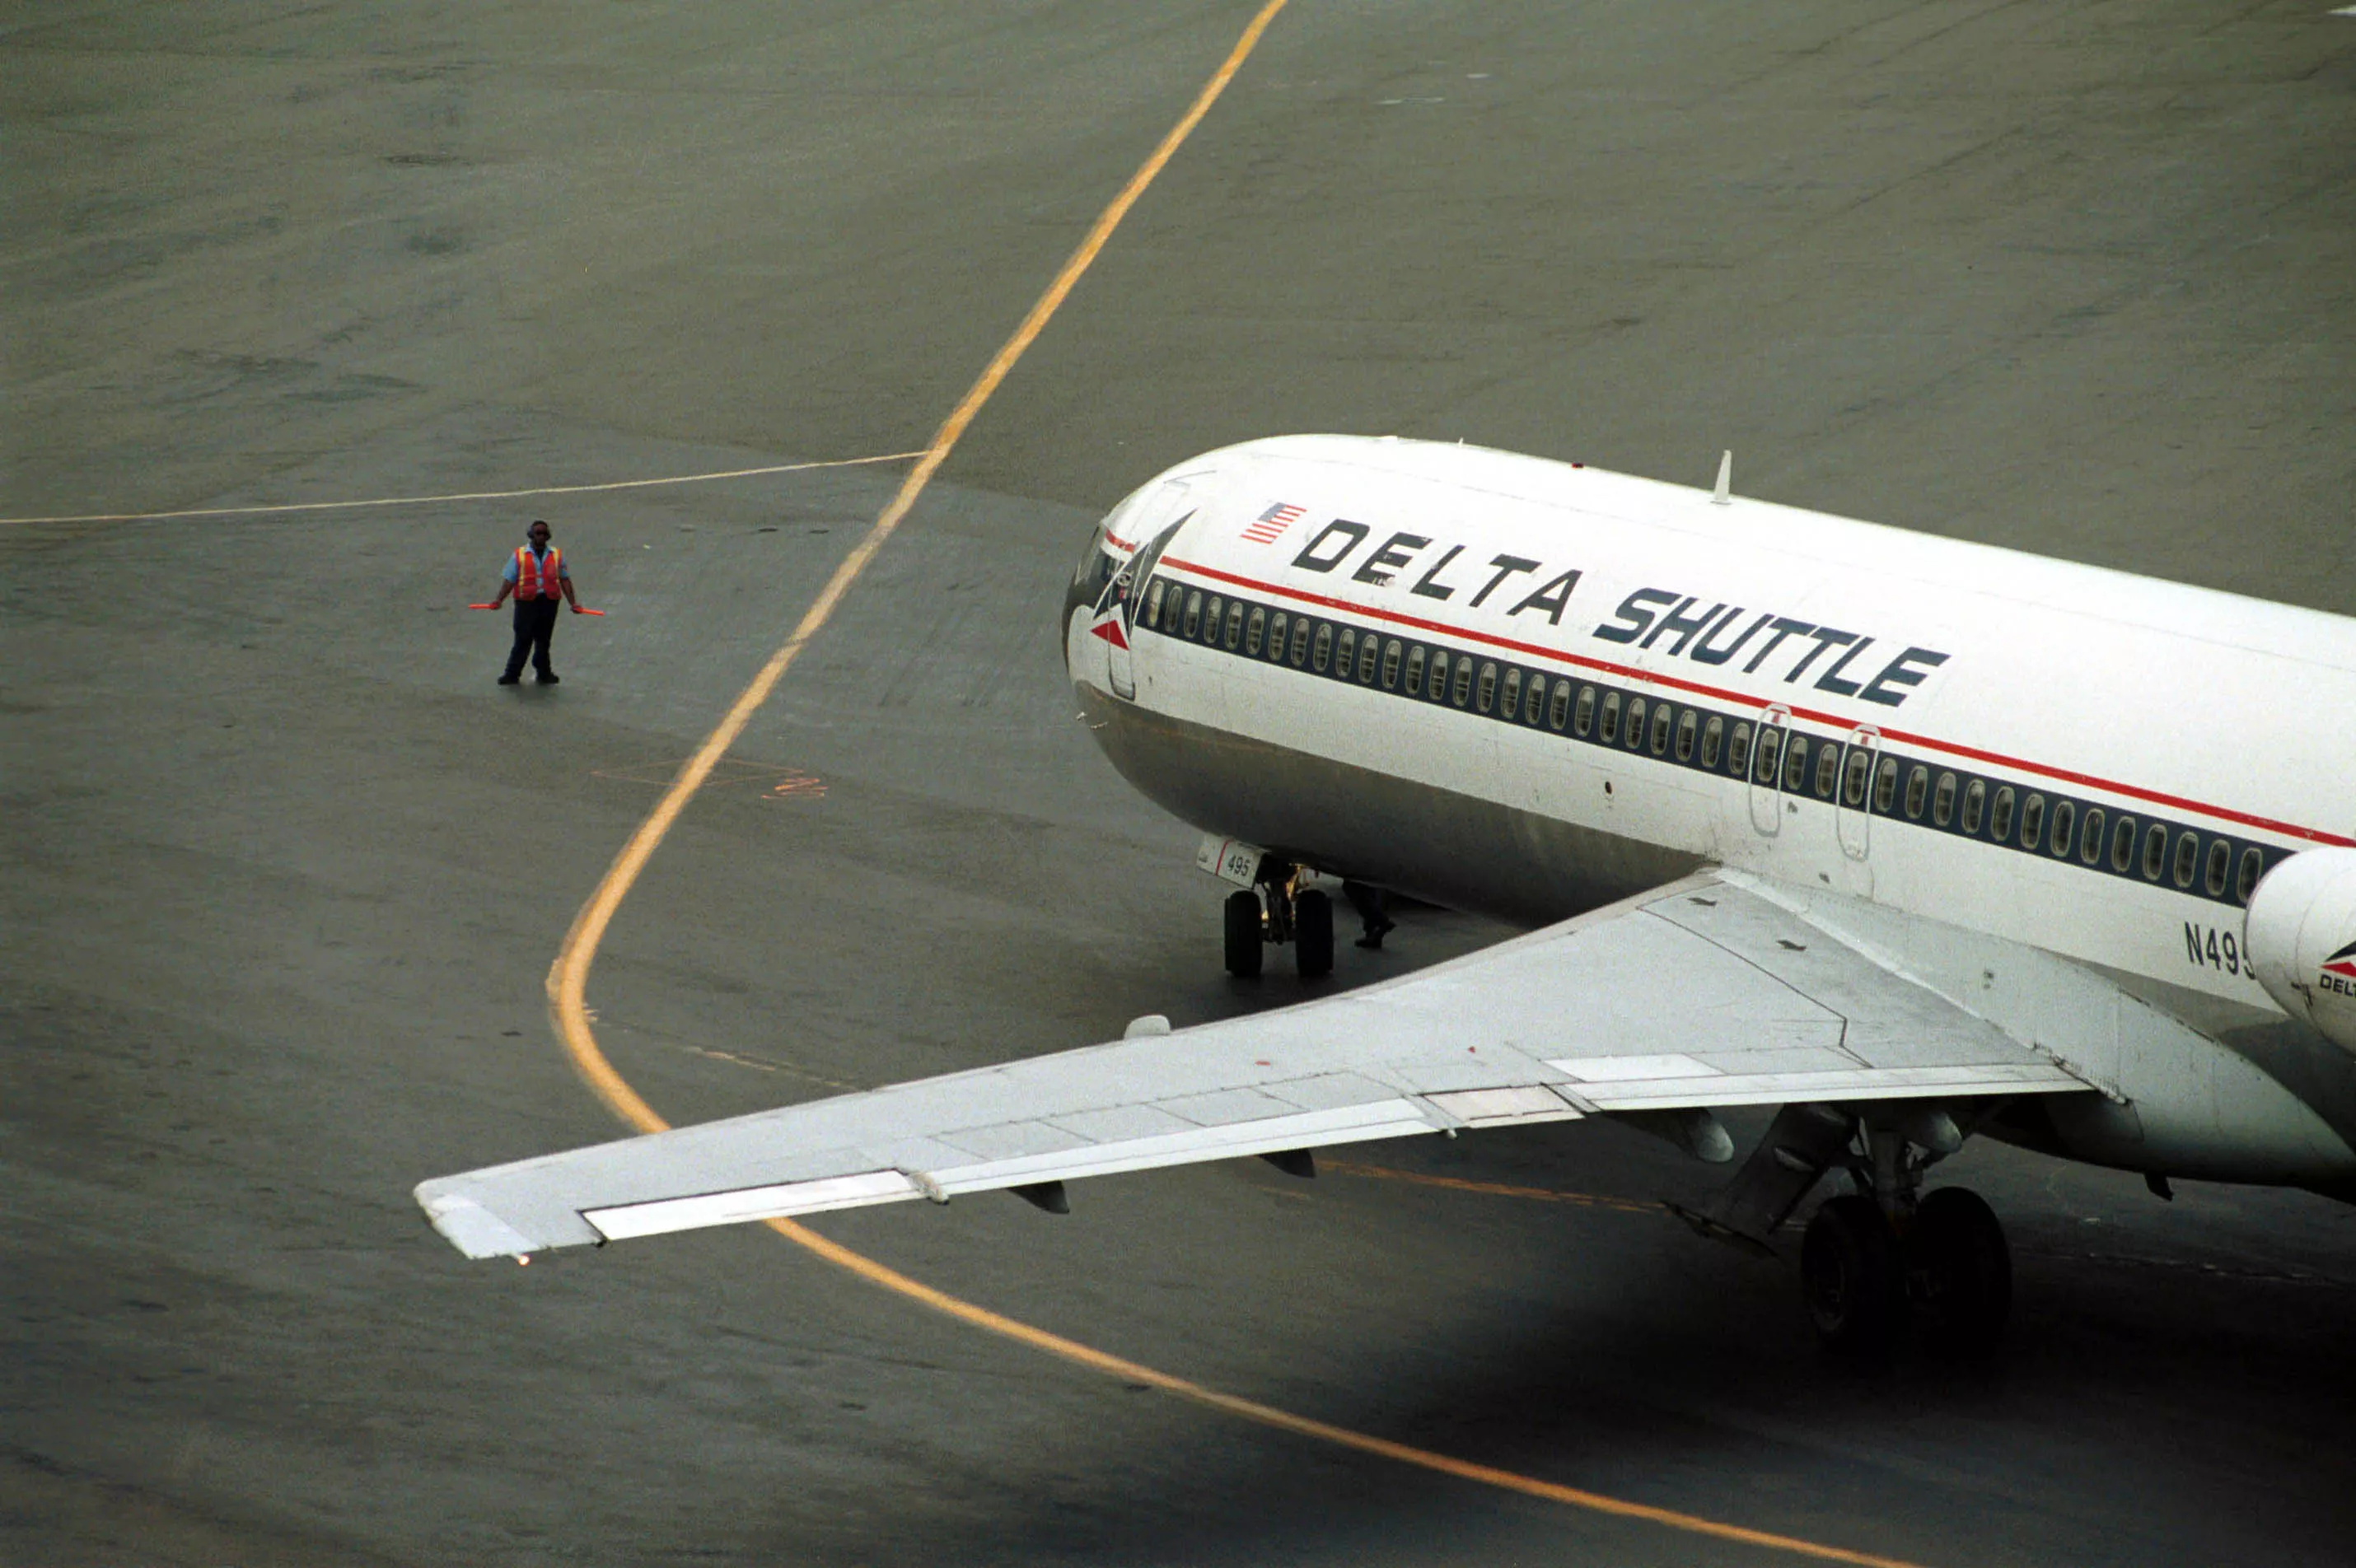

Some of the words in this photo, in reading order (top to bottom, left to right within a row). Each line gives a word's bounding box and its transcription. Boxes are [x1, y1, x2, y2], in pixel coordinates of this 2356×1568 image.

[1291, 519, 1583, 626] DELTA
[1592, 587, 1952, 707] SHUTTLE
[1227, 854, 1250, 877] 495
